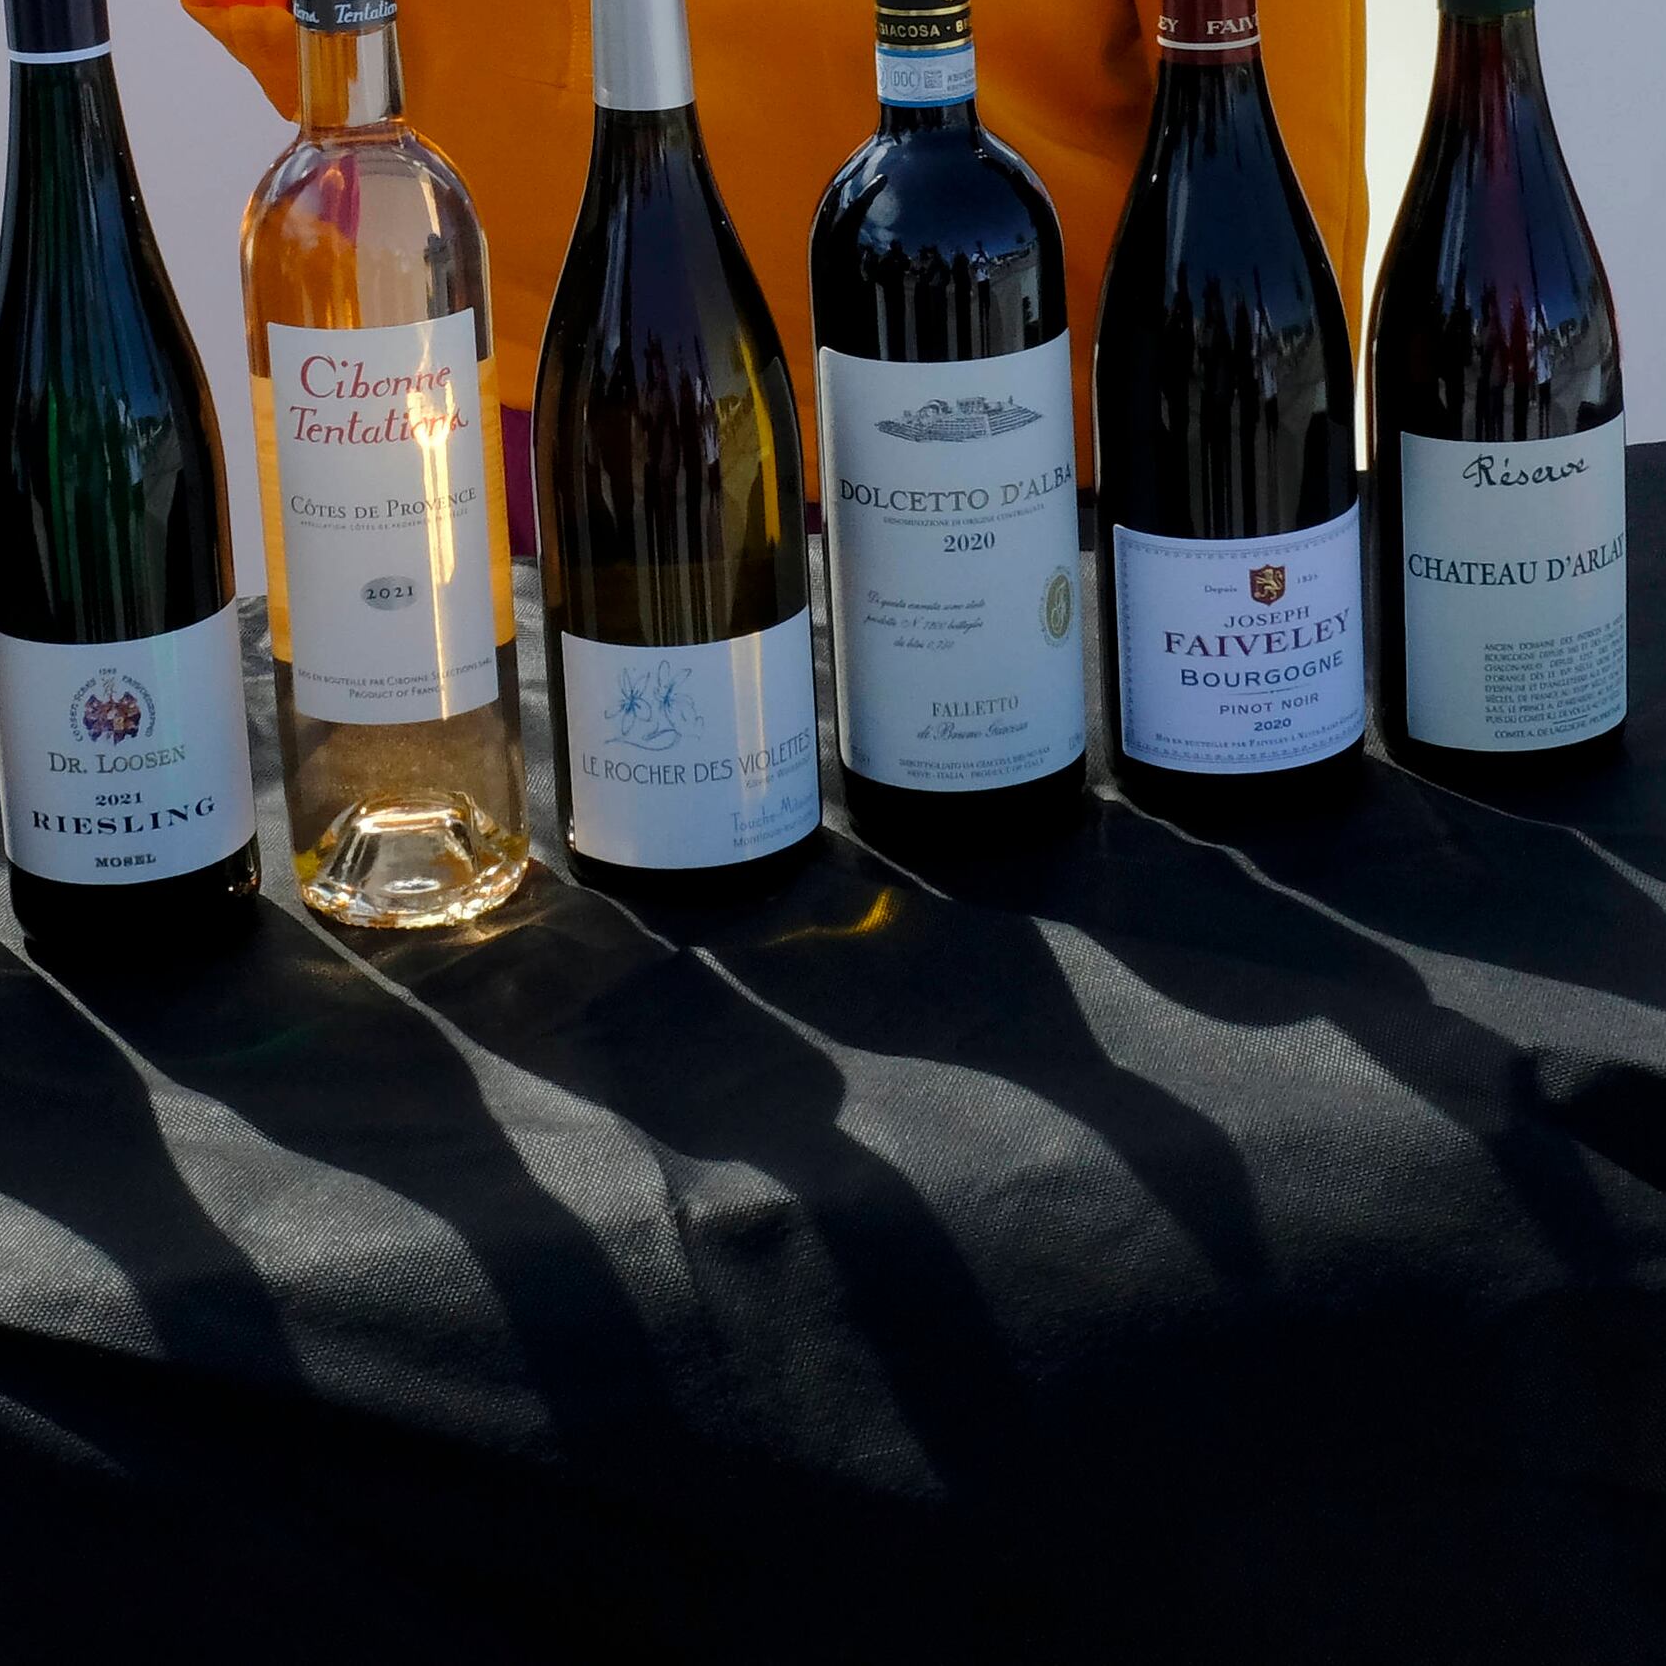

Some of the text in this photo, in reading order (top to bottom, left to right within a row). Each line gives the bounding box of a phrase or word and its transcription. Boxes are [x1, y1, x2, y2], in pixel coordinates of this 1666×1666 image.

[300, 354, 451, 399] Cibonne
[1462, 453, 1590, 488] Réserve
[839, 462, 1072, 513] DOLCETTO D'ALBA
[290, 494, 347, 520] CÔTES
[354, 505, 380, 520] DE
[386, 487, 478, 518] PROVENCE
[943, 531, 995, 553] 2020
[1408, 553, 1538, 586] CHATEAU
[365, 585, 415, 601] 2021
[1163, 607, 1351, 658] FAIVELEY
[1224, 606, 1309, 629] JOSEPH
[1181, 650, 1343, 688] BOURGOGNE
[932, 695, 1019, 718] FALLETTO
[1219, 692, 1320, 715] PINOT NOIR
[1254, 717, 1292, 732] 2020
[96, 744, 187, 774] LOOSEN
[582, 752, 599, 777] LE
[605, 761, 686, 785] ROCHER
[694, 759, 733, 783] DES
[32, 795, 216, 835] RIESLING
[95, 792, 143, 807] 2021
[95, 853, 157, 868] MOSEL
